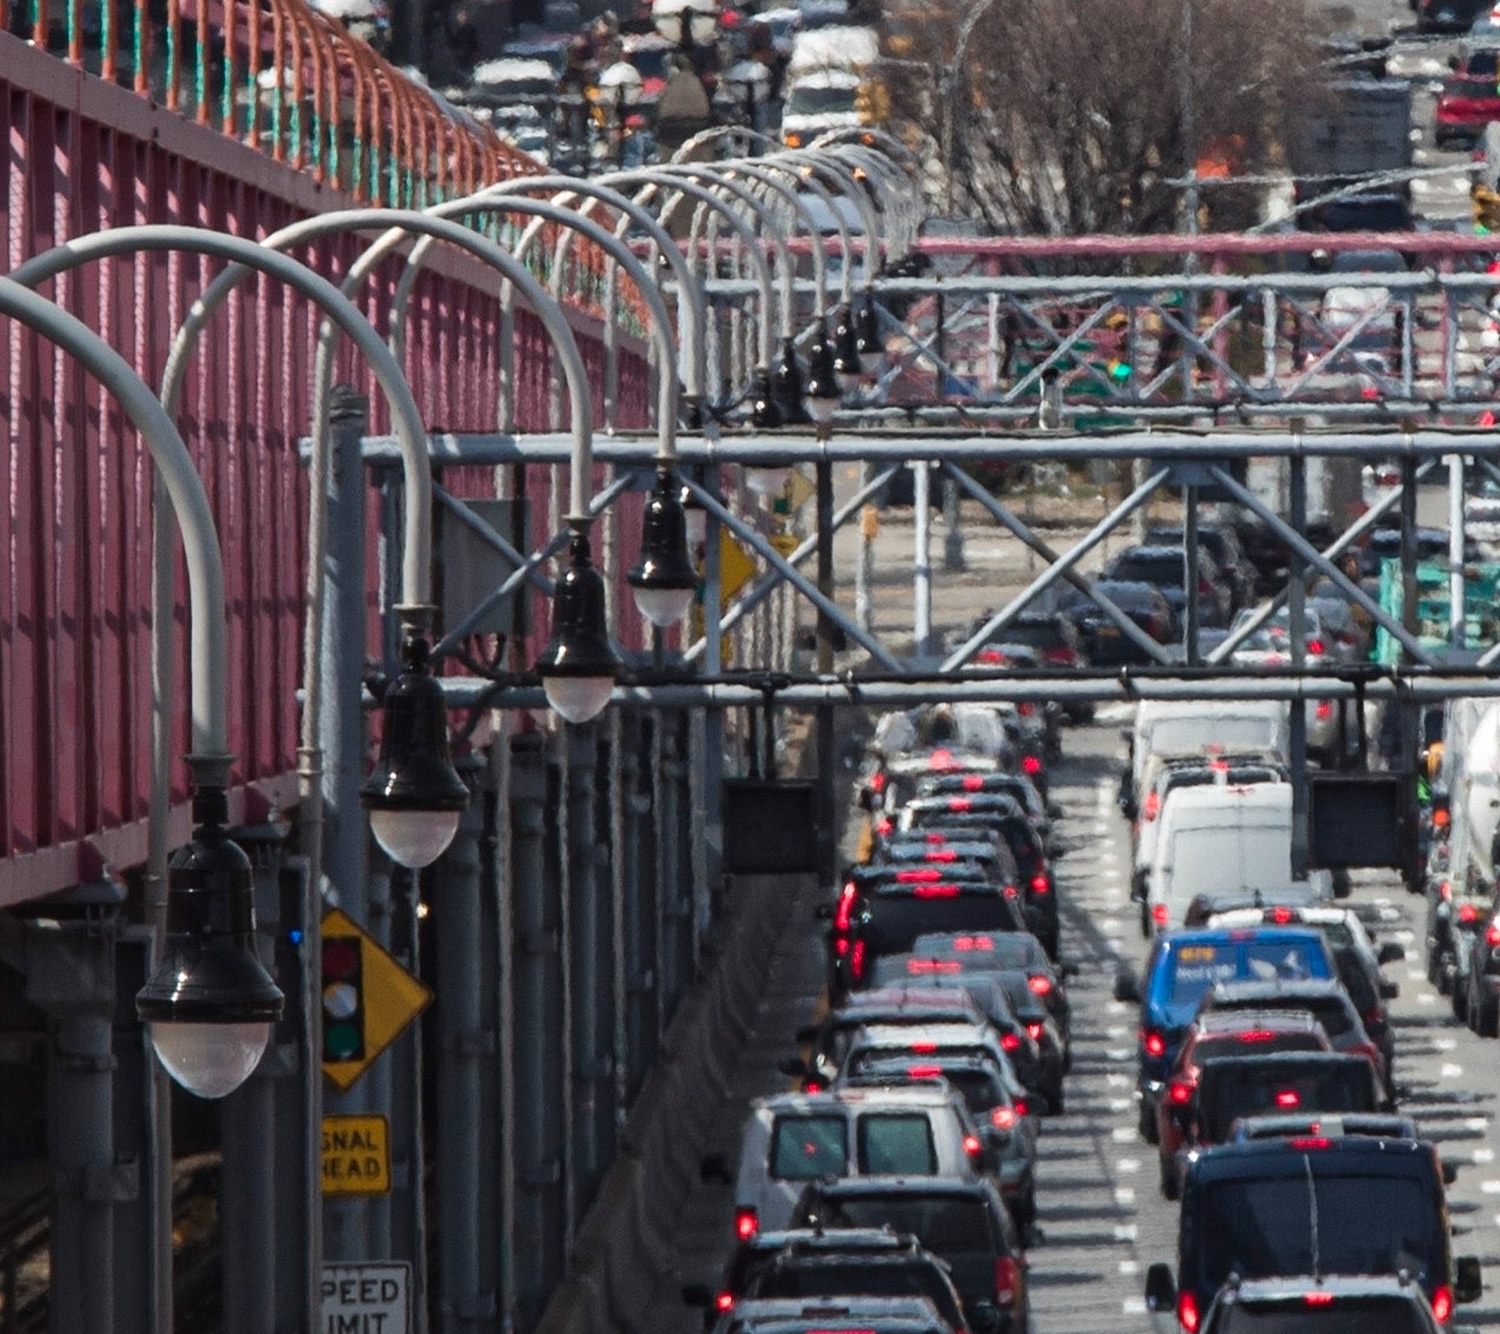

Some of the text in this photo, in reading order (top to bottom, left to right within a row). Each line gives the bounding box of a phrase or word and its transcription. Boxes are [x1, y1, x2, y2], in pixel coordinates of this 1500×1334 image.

[322, 1131, 378, 1150] GNAL
[323, 1157, 381, 1177] EAD
[320, 1279, 399, 1305] PEED
